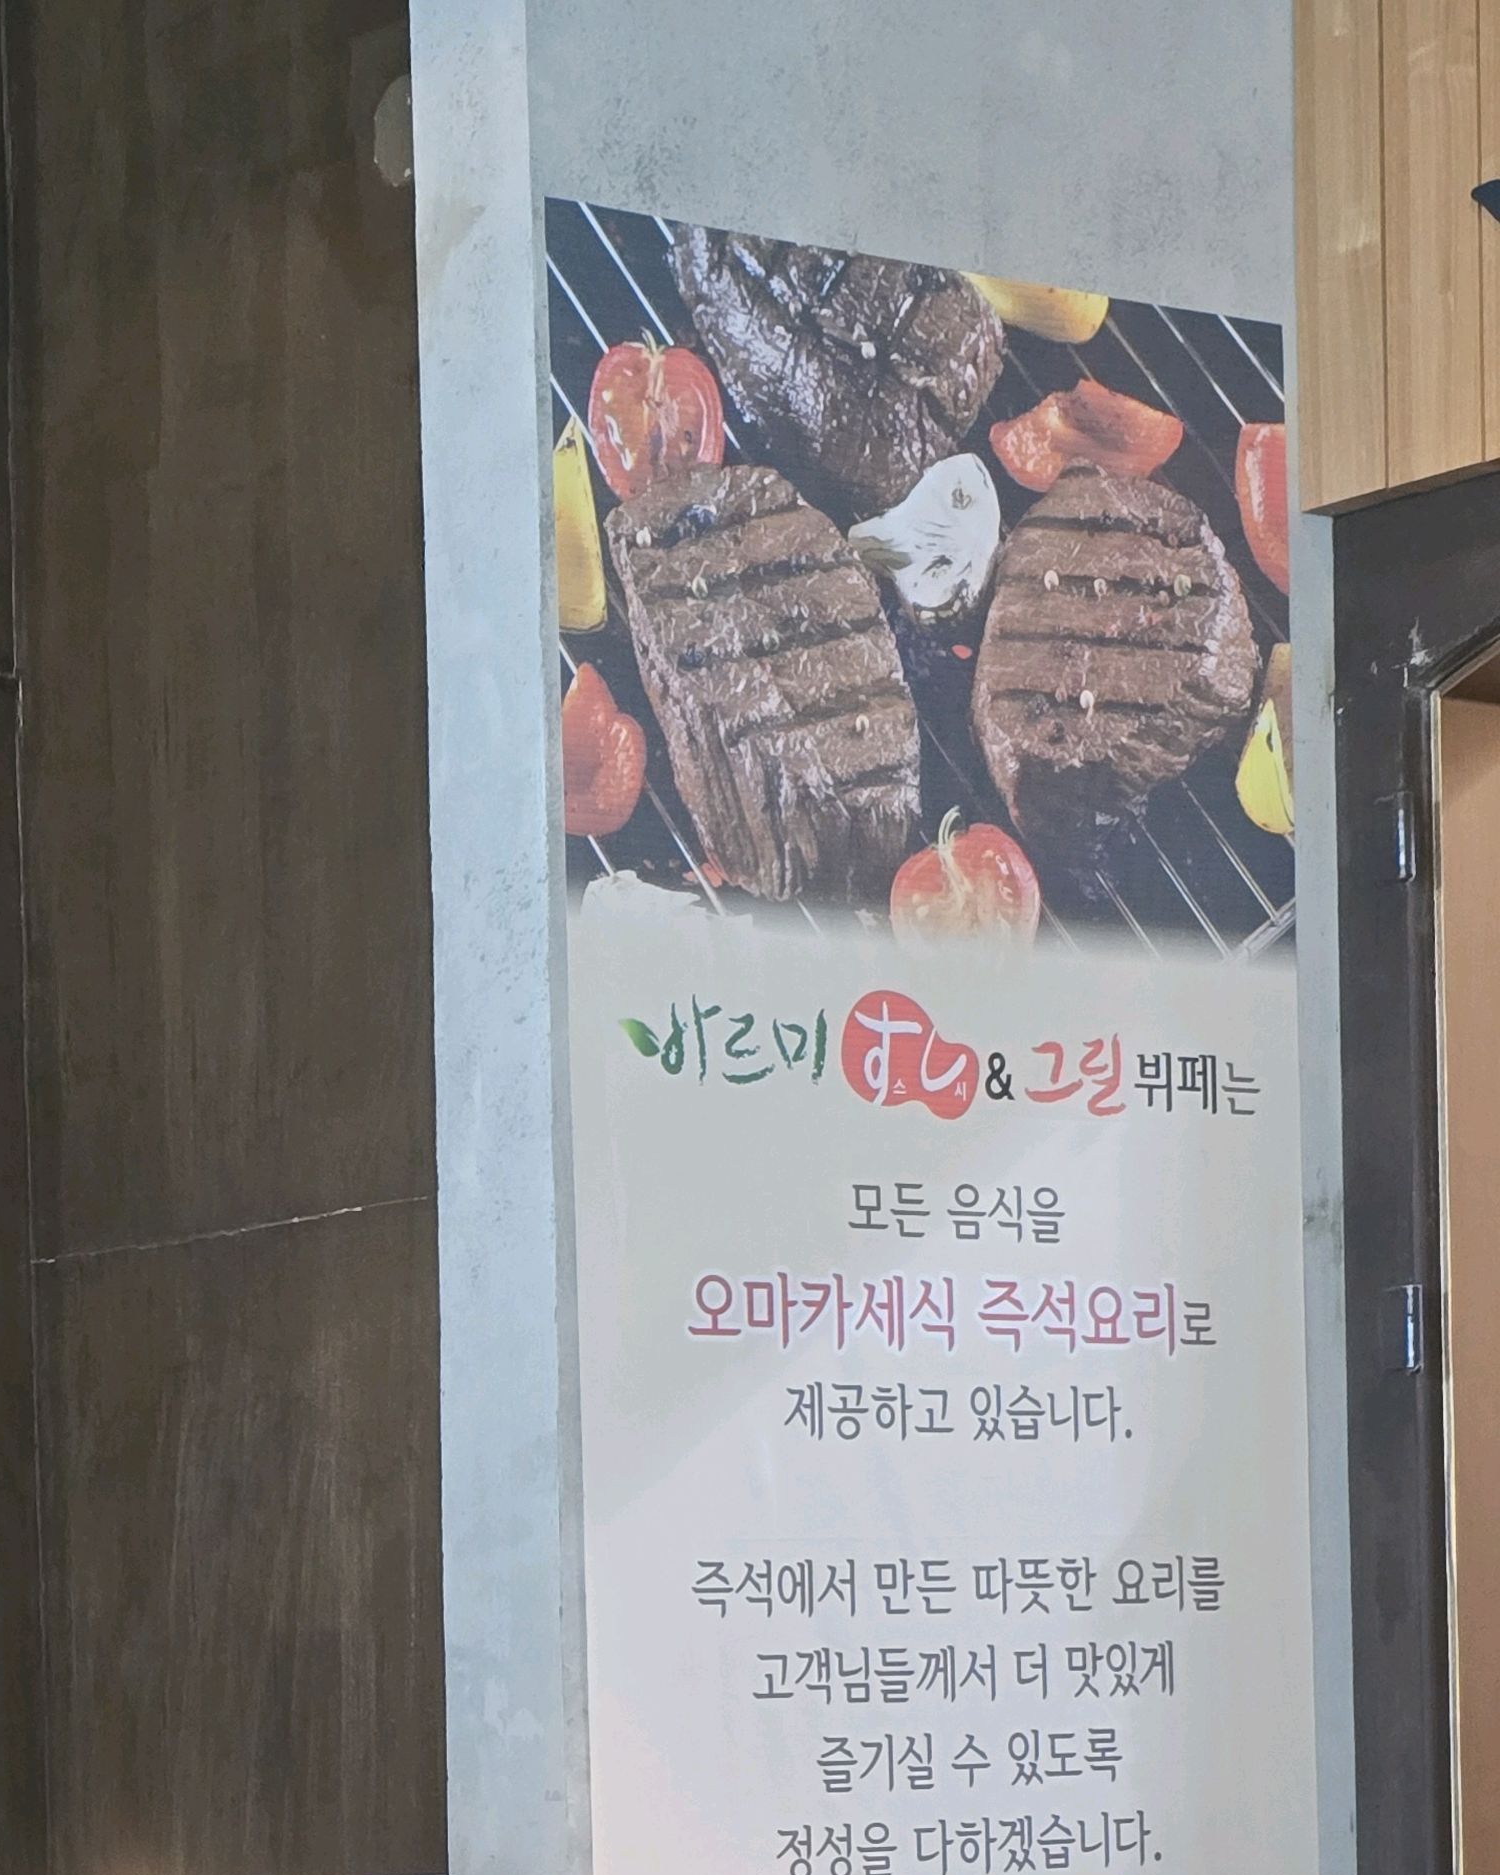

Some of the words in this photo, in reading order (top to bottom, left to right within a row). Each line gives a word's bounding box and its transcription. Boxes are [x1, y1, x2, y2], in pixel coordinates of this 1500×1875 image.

[618, 994, 827, 1085] 바르미
[985, 1052, 1014, 1101] &
[1024, 1033, 1127, 1116] 그릴
[1134, 1052, 1261, 1116] 뷔페는
[848, 1182, 930, 1238] 모든
[947, 1182, 1065, 1243] 음식을
[688, 1271, 955, 1352] 오마카세식
[978, 1279, 1217, 1355] 즉석요리로
[784, 1382, 954, 1443] 제공하고
[971, 1385, 1134, 1447] 있습니다.
[691, 1558, 857, 1618] 즉석에서
[874, 1558, 957, 1614] 만든
[972, 1556, 1096, 1614] 따뜻한
[1111, 1555, 1225, 1611] 요리를
[753, 1643, 998, 1704] 고객님들께서
[1015, 1645, 1049, 1700] 더
[1065, 1641, 1174, 1698] 맛있게
[816, 1732, 934, 1792] 즐기실
[951, 1733, 992, 1788] 수
[1007, 1727, 1123, 1786] 있도록
